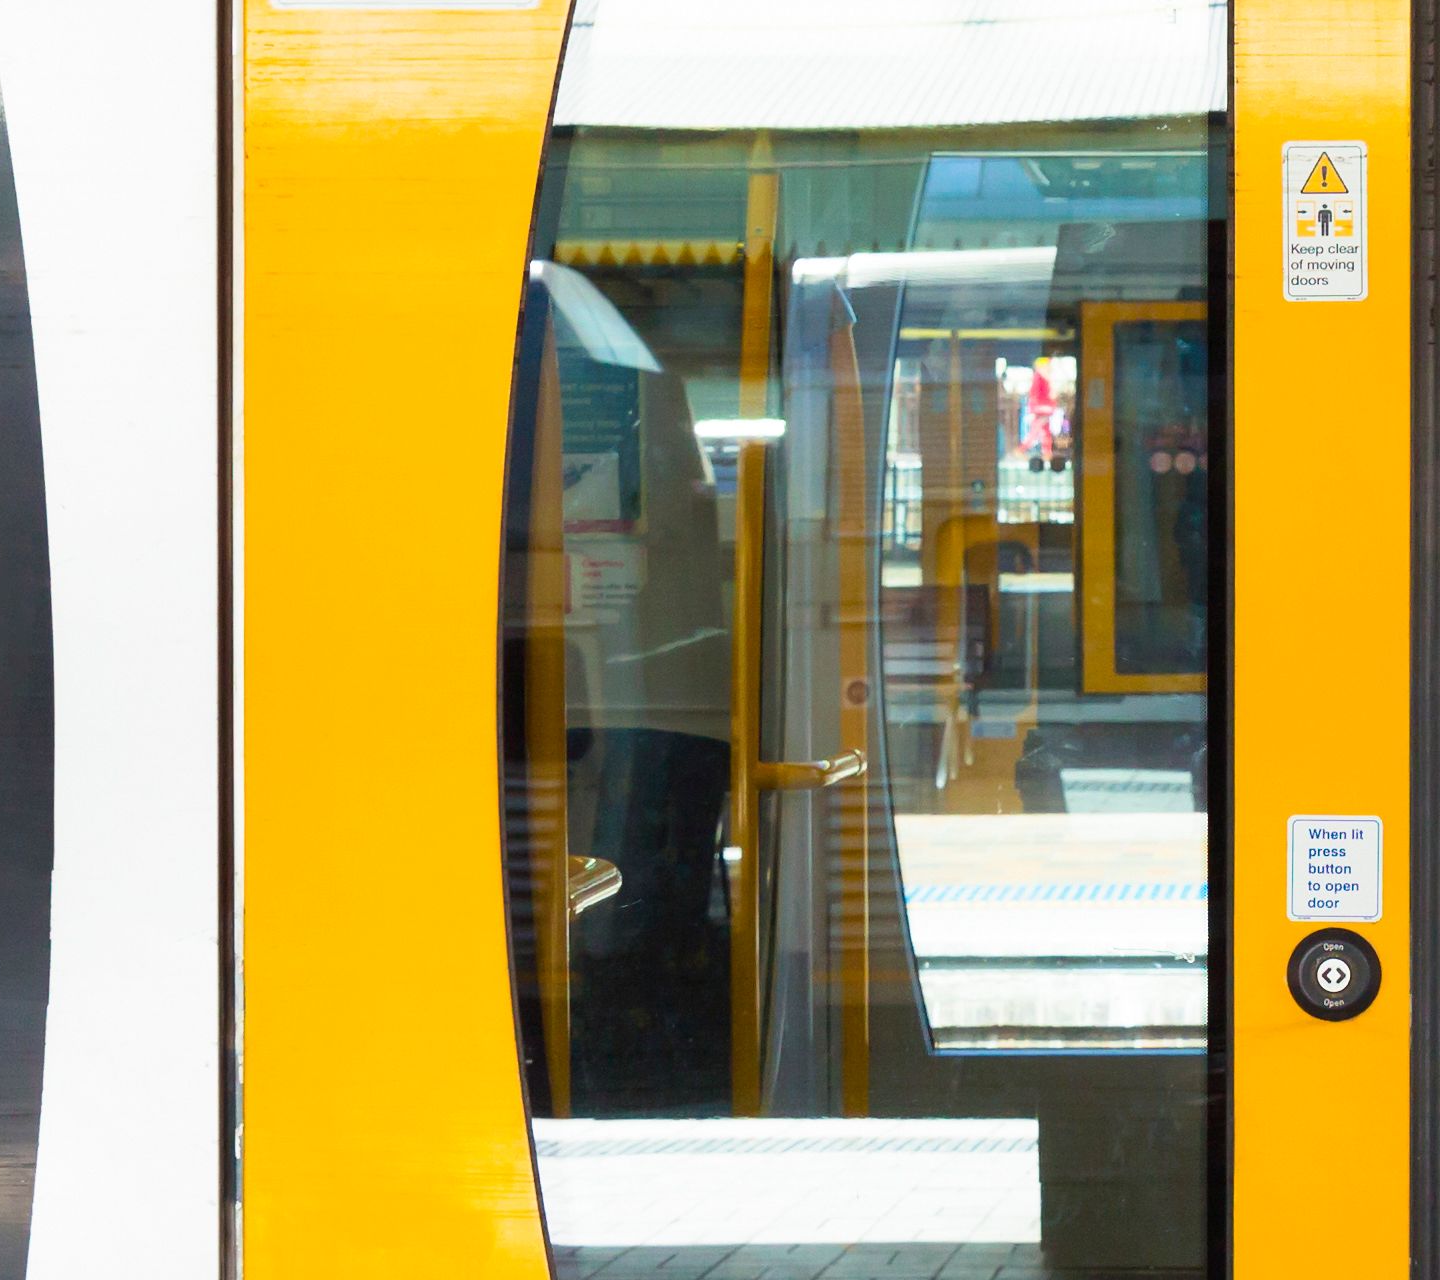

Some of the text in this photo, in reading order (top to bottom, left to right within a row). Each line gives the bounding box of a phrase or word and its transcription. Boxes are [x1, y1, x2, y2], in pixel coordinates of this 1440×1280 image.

[1291, 243, 1359, 257] Keep clear
[1290, 259, 1355, 273] of moving
[1290, 275, 1329, 286] doors
[1308, 828, 1364, 840] When lit
[1308, 847, 1347, 859] press
[1308, 863, 1352, 875] button
[1307, 880, 1359, 894] to open
[1307, 898, 1340, 909] door
[1323, 942, 1344, 951] Open
[1323, 998, 1345, 1008] Open
